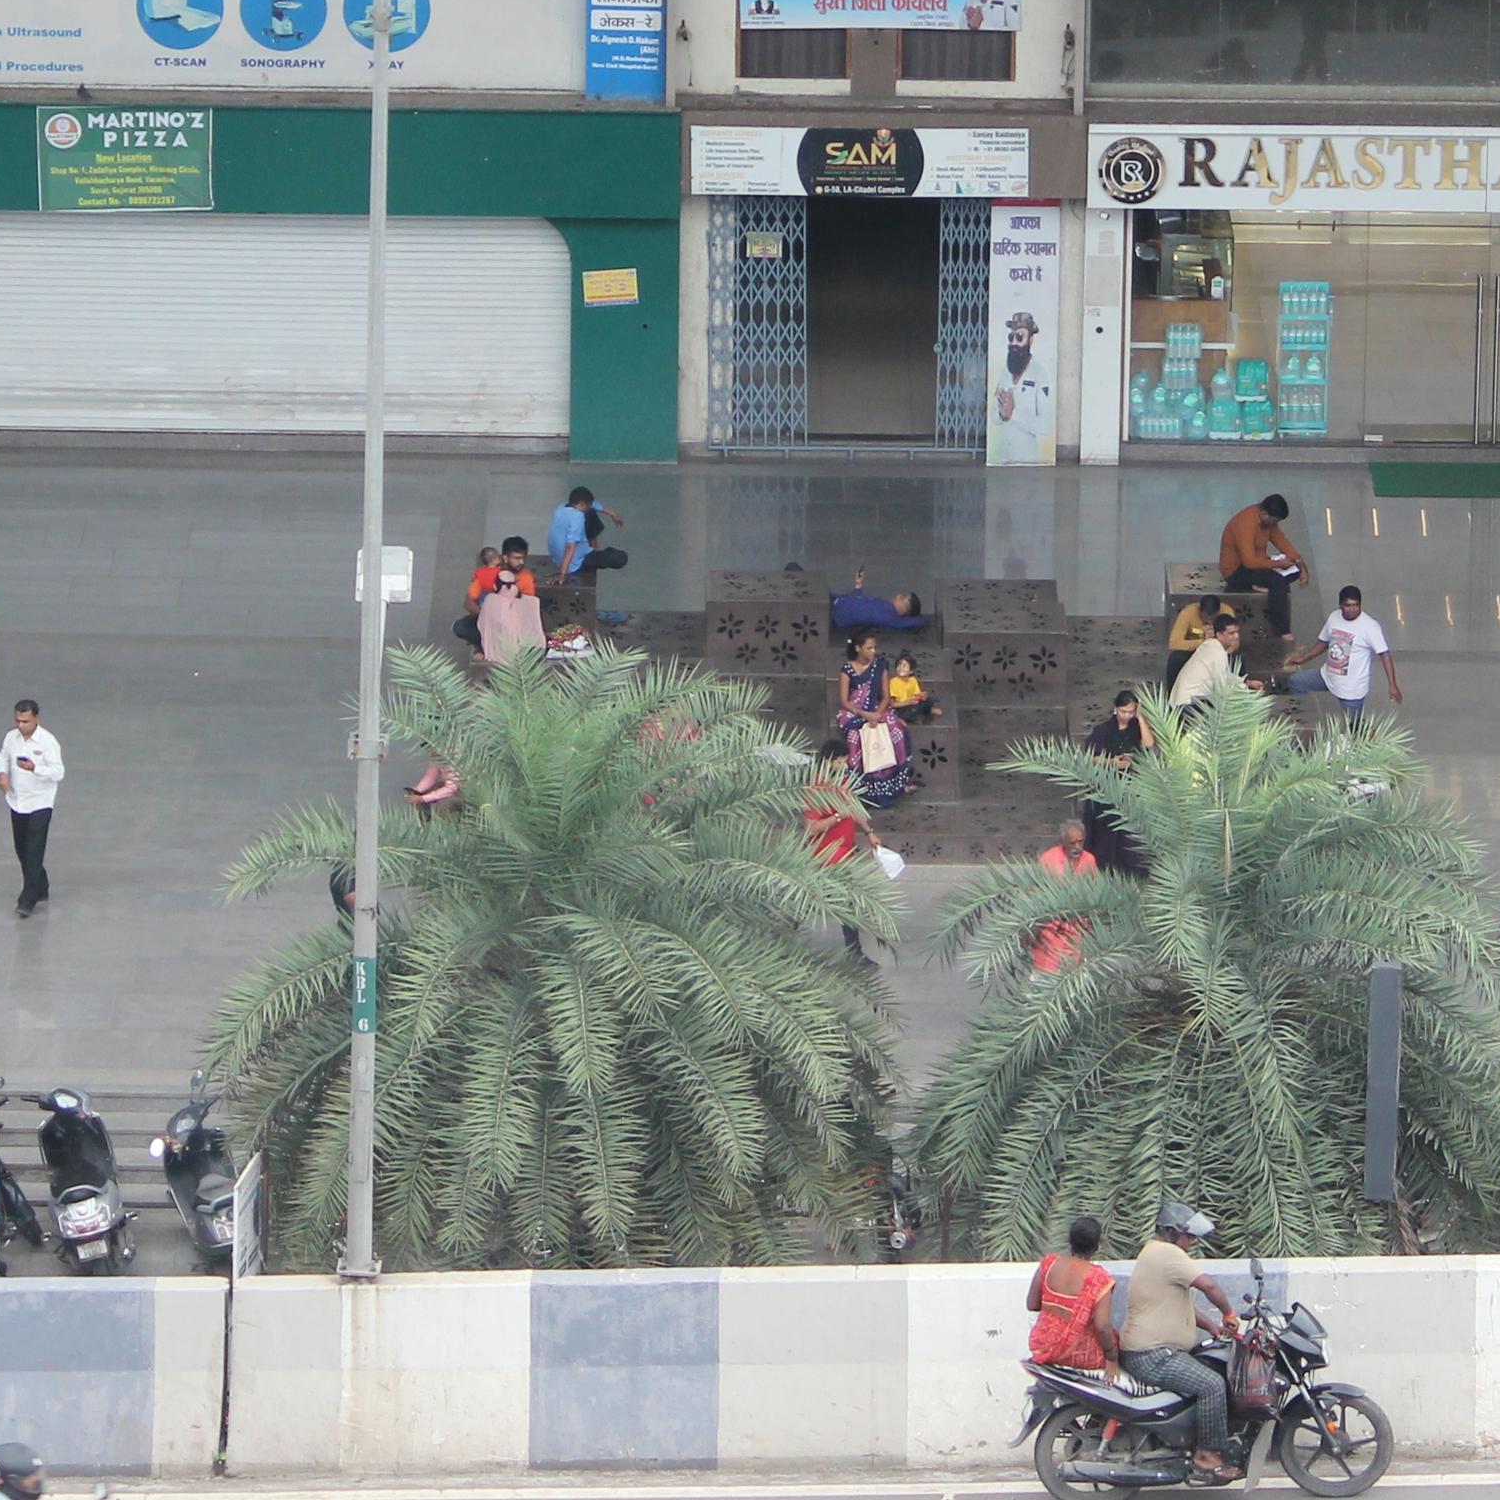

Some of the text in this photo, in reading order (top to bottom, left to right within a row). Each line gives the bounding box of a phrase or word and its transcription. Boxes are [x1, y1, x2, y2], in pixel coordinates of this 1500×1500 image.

[6, 26, 83, 38] Ultrasound
[6, 61, 84, 73] Procedures
[154, 57, 207, 68] CT-SCAN
[240, 58, 326, 70] SONOGRAPHY
[103, 131, 189, 148] PIZZA
[1010, 216, 1041, 230] आपका
[1024, 242, 1057, 256] स्वागत
[355, 961, 369, 1032] KBL 6
